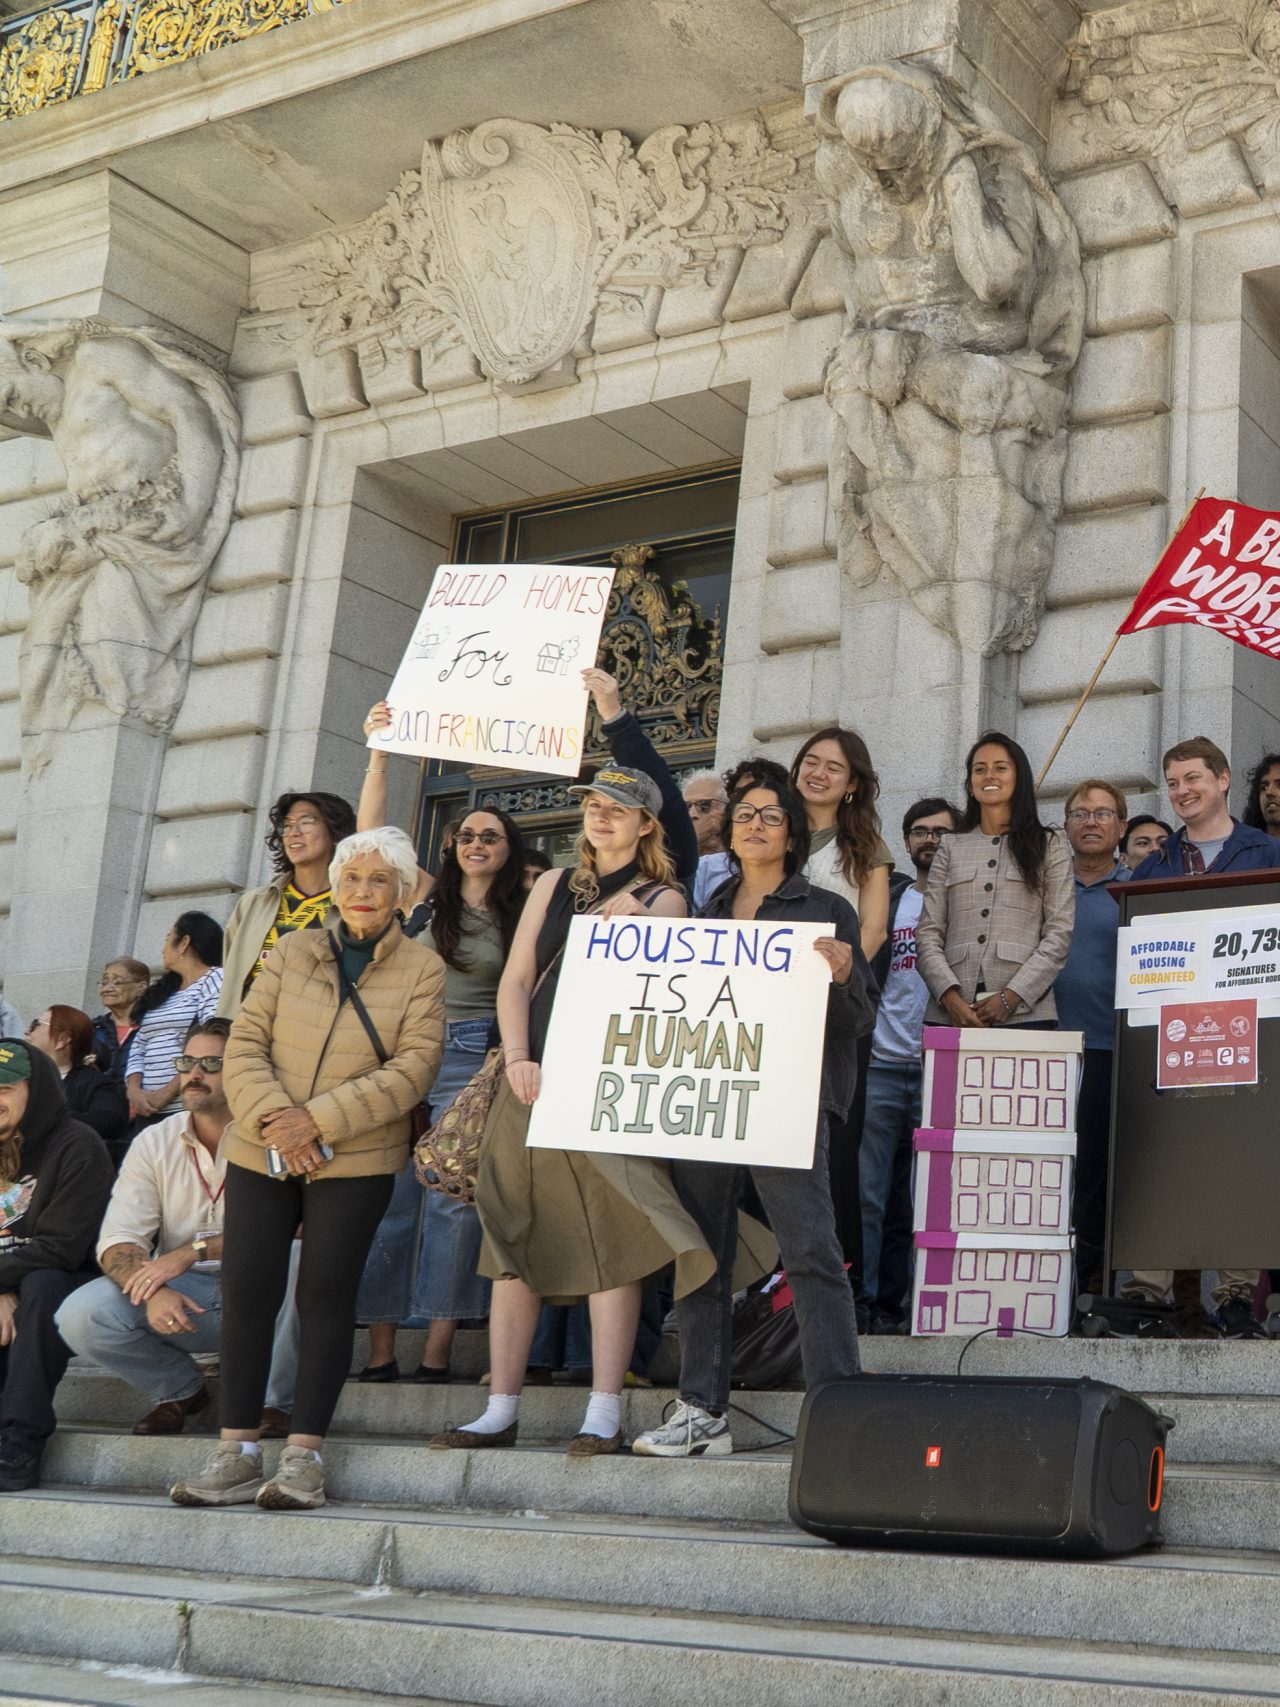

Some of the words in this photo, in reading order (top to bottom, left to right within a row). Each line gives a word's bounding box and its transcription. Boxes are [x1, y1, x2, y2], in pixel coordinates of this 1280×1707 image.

[1200, 509, 1235, 557] A
[429, 572, 507, 608] BUILD
[523, 574, 611, 614] HOMES
[437, 713, 579, 760] FRANCISCANS
[586, 922, 794, 973] HOUSING
[1131, 940, 1196, 956] AFFORDABLE
[1139, 957, 1185, 970] HOUSING
[1129, 971, 1195, 985] GUARANTEED
[1215, 981, 1226, 989] FOR
[1227, 977, 1264, 988] AFFORDABLE
[1227, 963, 1276, 978] SIGNATURES
[630, 973, 688, 1013] IS
[707, 975, 738, 1018] A
[602, 1013, 763, 1072] HUMAN
[591, 1071, 760, 1140] RIGHT
